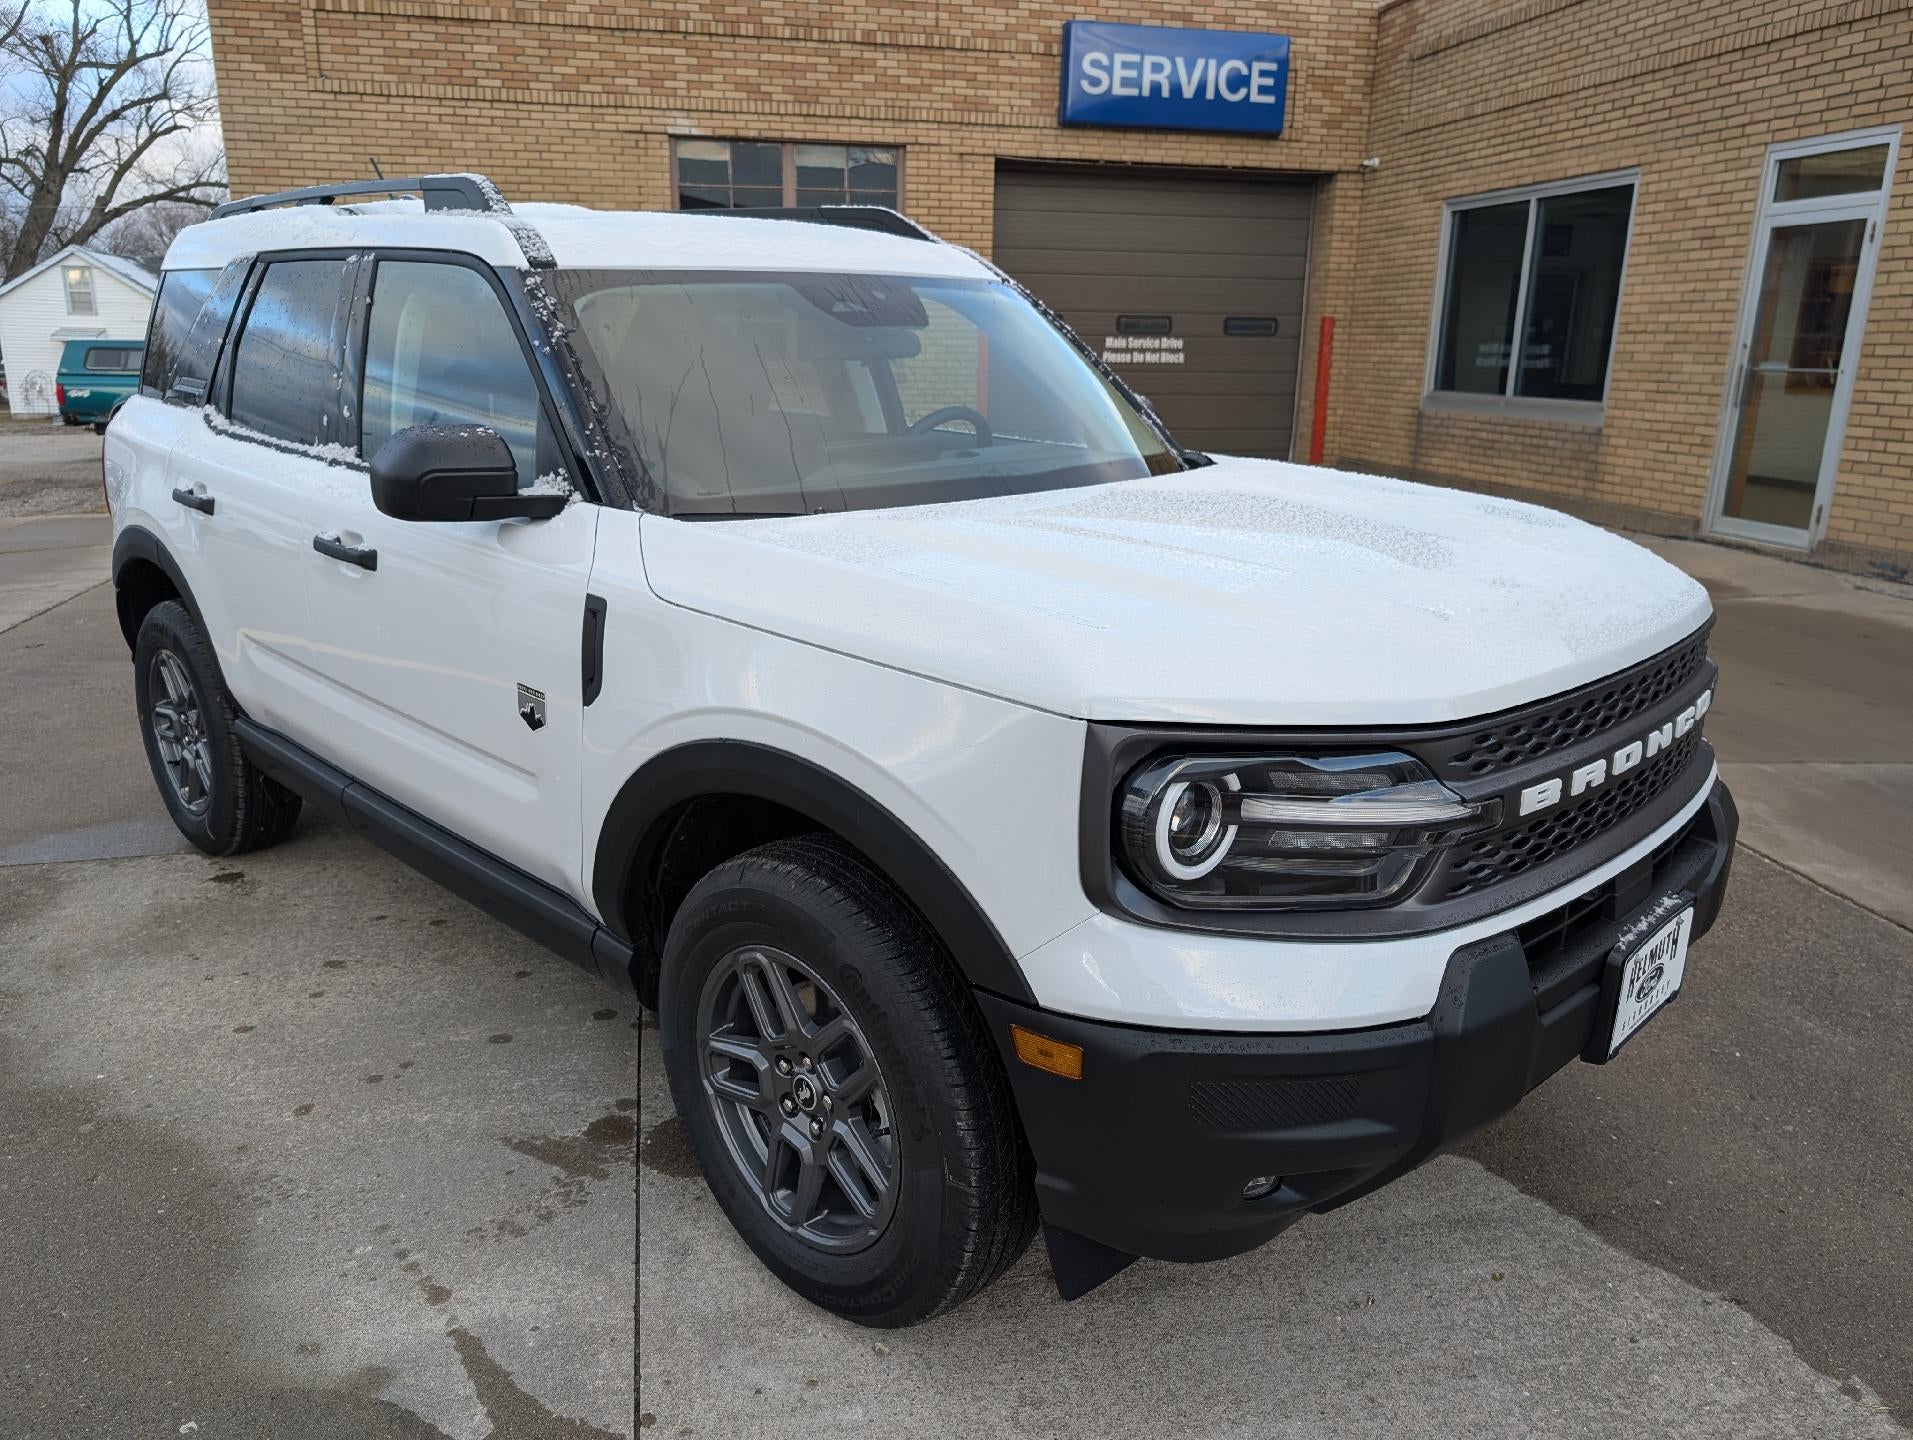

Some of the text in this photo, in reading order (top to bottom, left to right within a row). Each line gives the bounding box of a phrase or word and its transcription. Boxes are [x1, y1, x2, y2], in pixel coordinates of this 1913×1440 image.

[1080, 52, 1278, 104] SERVICE
[1103, 351, 1184, 363] Please Do Not Block
[1105, 336, 1183, 349] Main Service Drive
[1519, 689, 1711, 816] BRONCO
[1626, 924, 1681, 1004] HELMUTH
